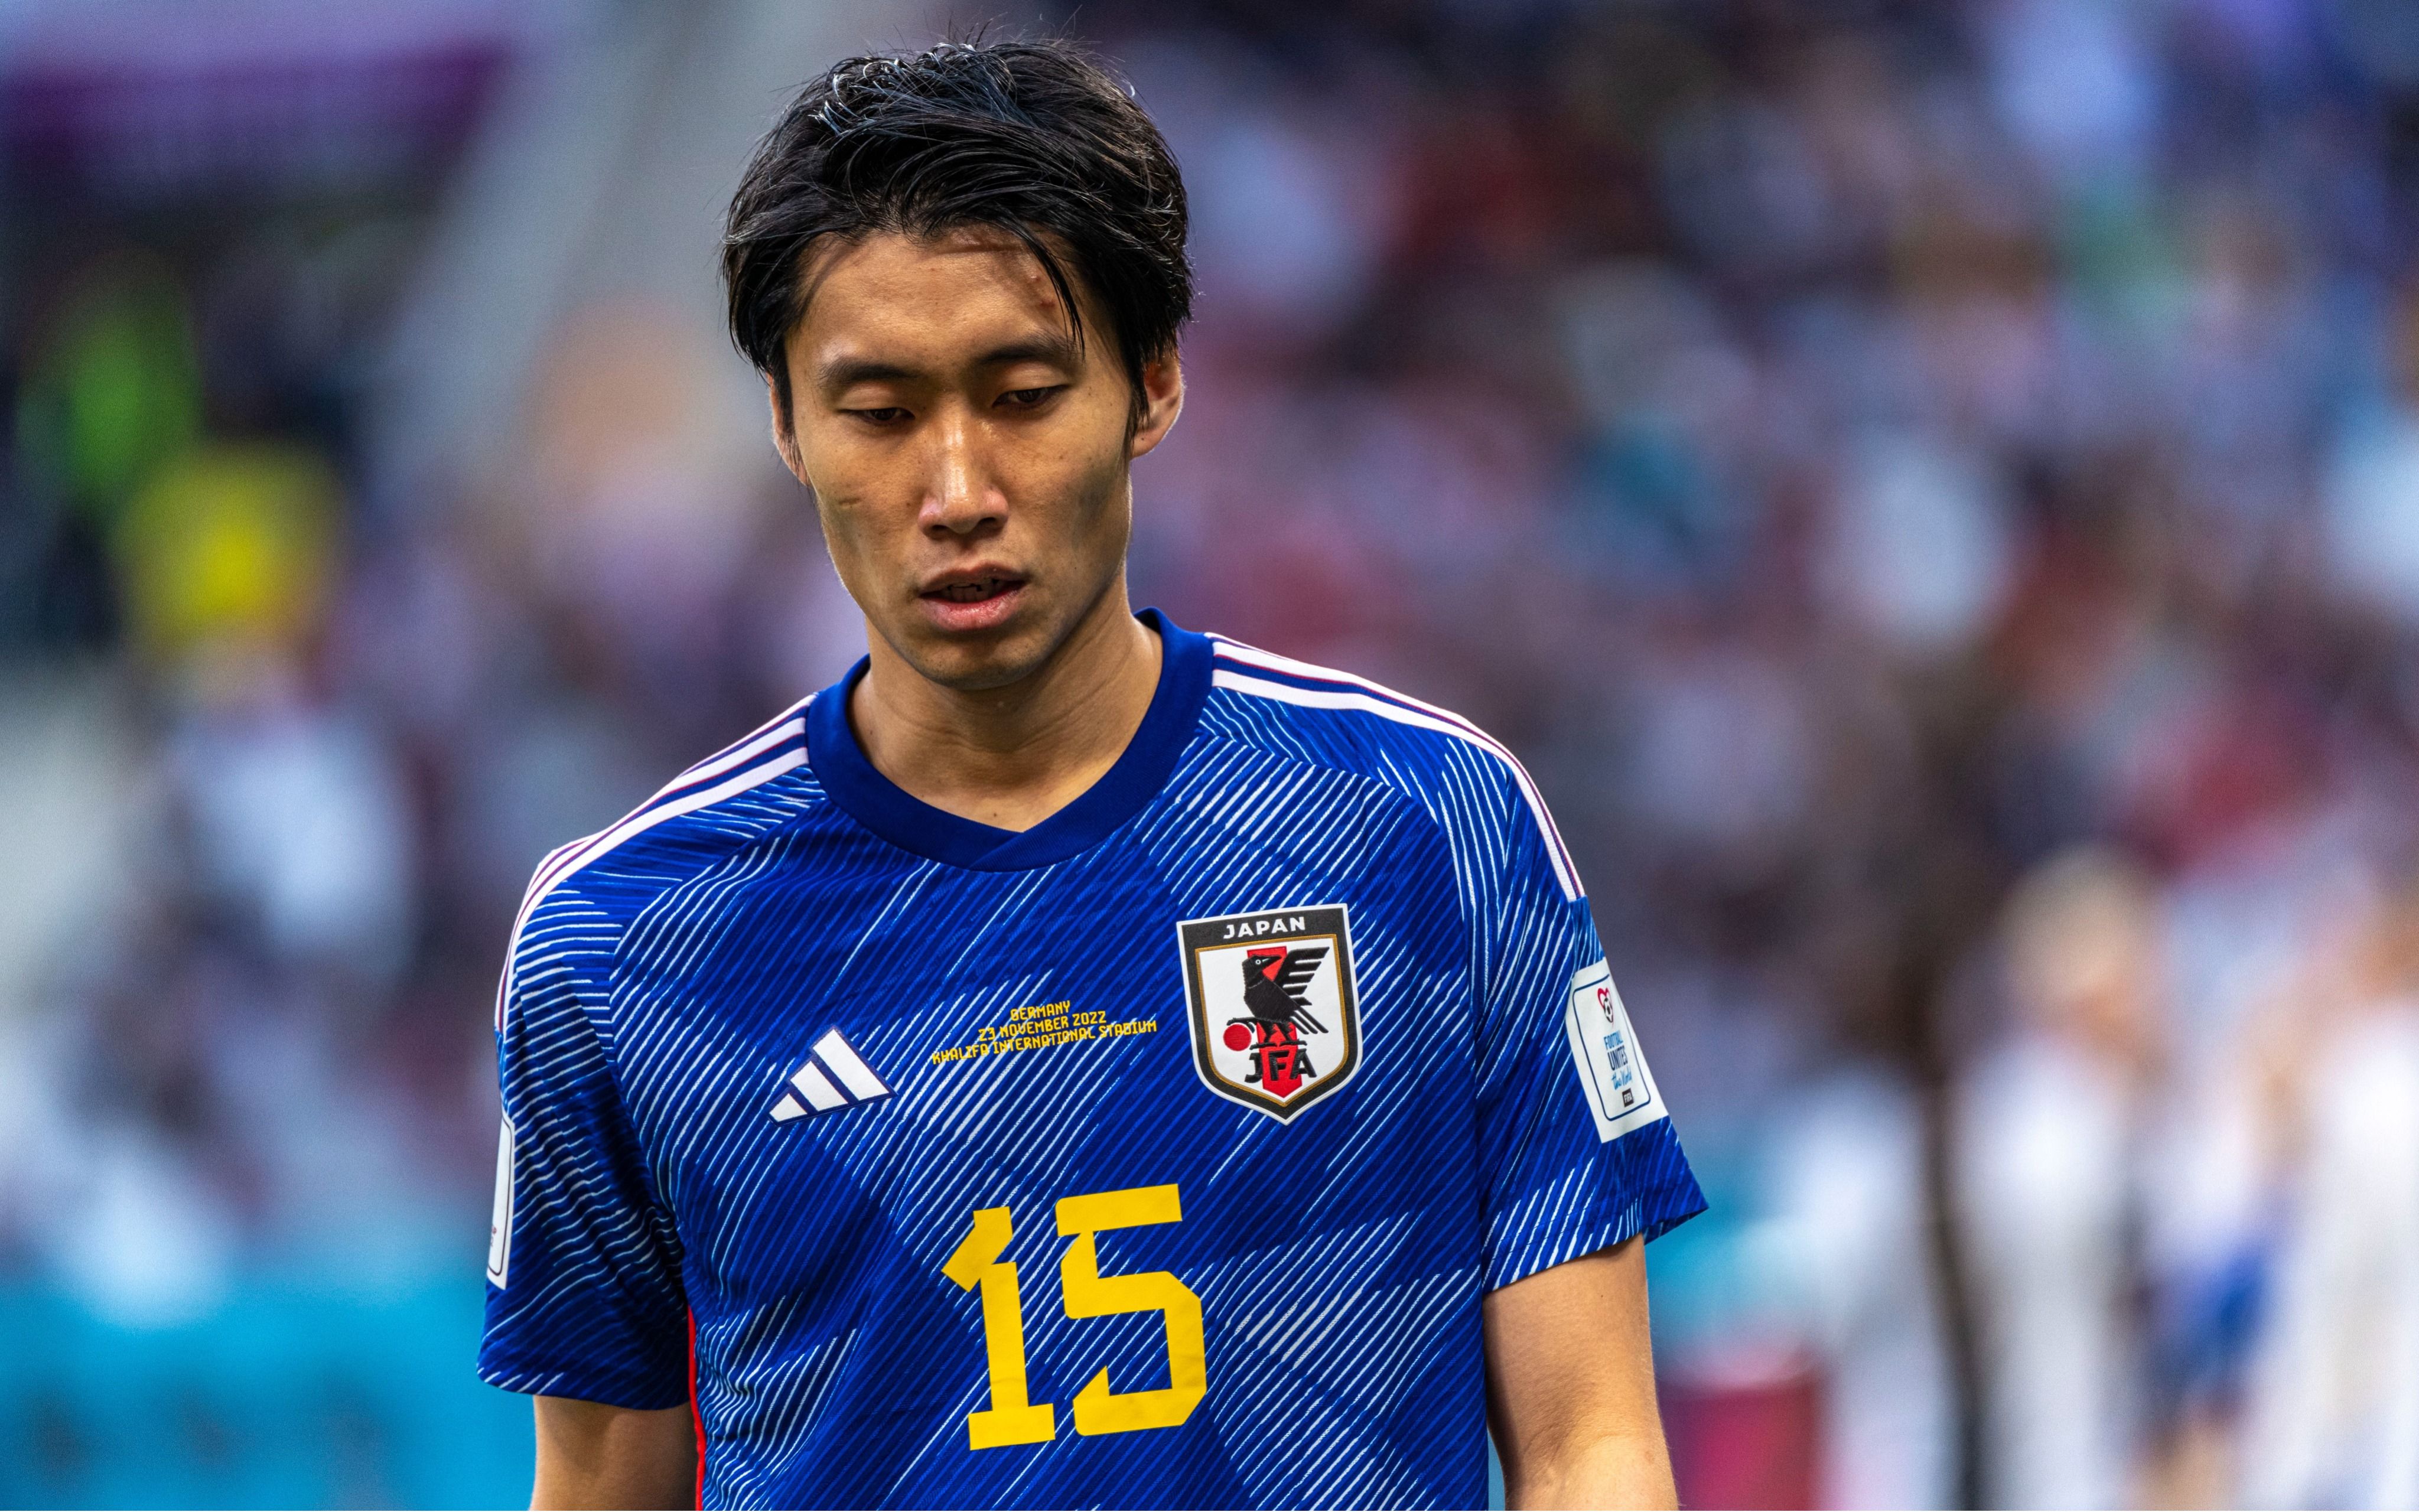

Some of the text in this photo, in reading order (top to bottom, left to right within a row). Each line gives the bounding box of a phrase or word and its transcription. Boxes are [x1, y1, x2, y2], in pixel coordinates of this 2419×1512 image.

[1223, 917, 1305, 939] JAPAN
[978, 1011, 1106, 1041] 23 NOVEMBER 2022
[1010, 1000, 1070, 1021] GERMANY
[932, 1021, 1157, 1065] KHALIFA INTERNATIONAL STADIUM
[1244, 1049, 1317, 1083] JFA
[941, 1184, 1207, 1450] 15
